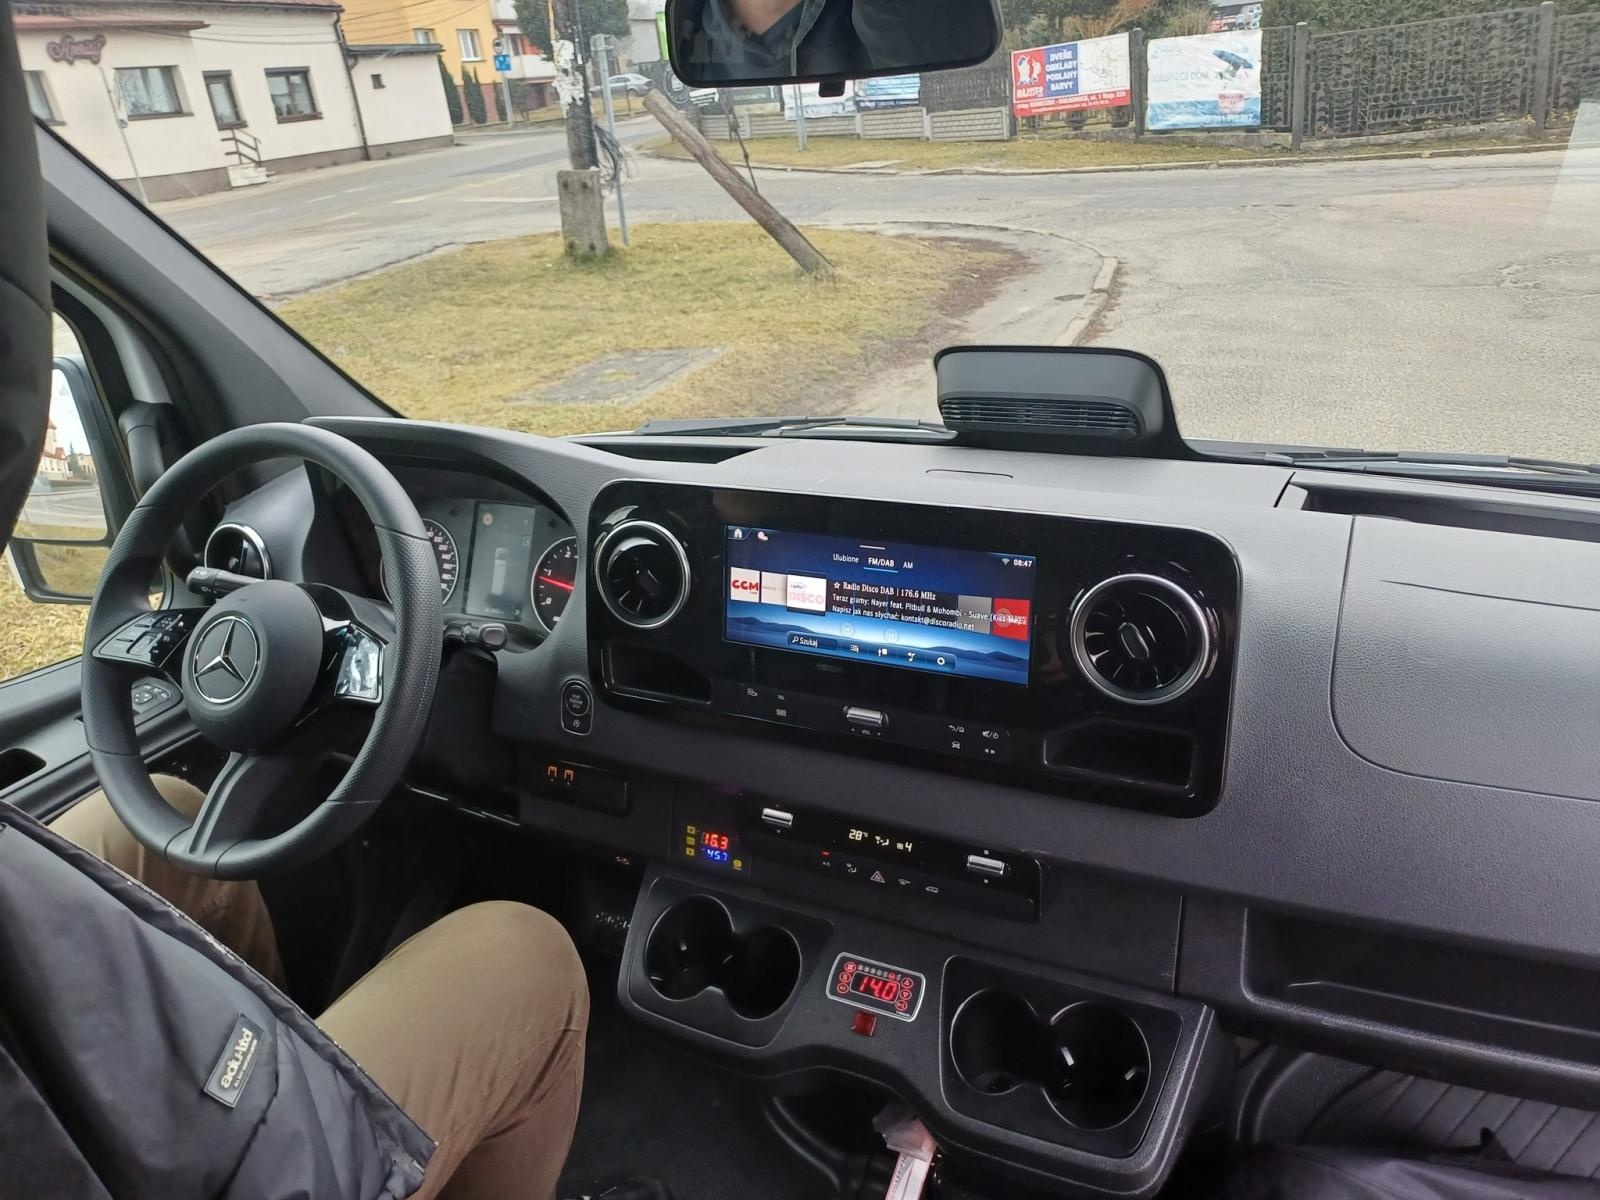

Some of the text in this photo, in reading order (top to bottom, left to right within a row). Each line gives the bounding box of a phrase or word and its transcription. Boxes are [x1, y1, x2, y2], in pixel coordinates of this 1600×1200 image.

[1050, 49, 1072, 62] DVEŘE
[1045, 60, 1077, 72] OBKLADY
[1046, 71, 1078, 82] PODLAHY
[1050, 82, 1074, 91] BARVY
[832, 553, 859, 563] Ulubione
[868, 557, 895, 567] FM/DAB
[1013, 559, 1032, 567] 08:47
[903, 561, 914, 569] AM
[843, 582, 860, 591] Radio
[862, 584, 878, 593] Disco
[880, 586, 894, 595] DAB
[901, 590, 919, 598] 176.6
[920, 591, 936, 600] MHz
[788, 592, 824, 604] DISCO
[849, 597, 870, 606] gramy:
[871, 599, 888, 607] Nayer
[890, 600, 904, 609] feat.
[905, 602, 925, 612] Pitbull
[933, 607, 962, 617] Mohombi
[968, 611, 988, 619] Suave
[832, 605, 852, 614] Napisz
[875, 611, 900, 620] słychać:
[901, 613, 975, 631] kontakt@discoradio.net
[800, 637, 818, 648] Szukaj
[905, 842, 912, 852] 4
